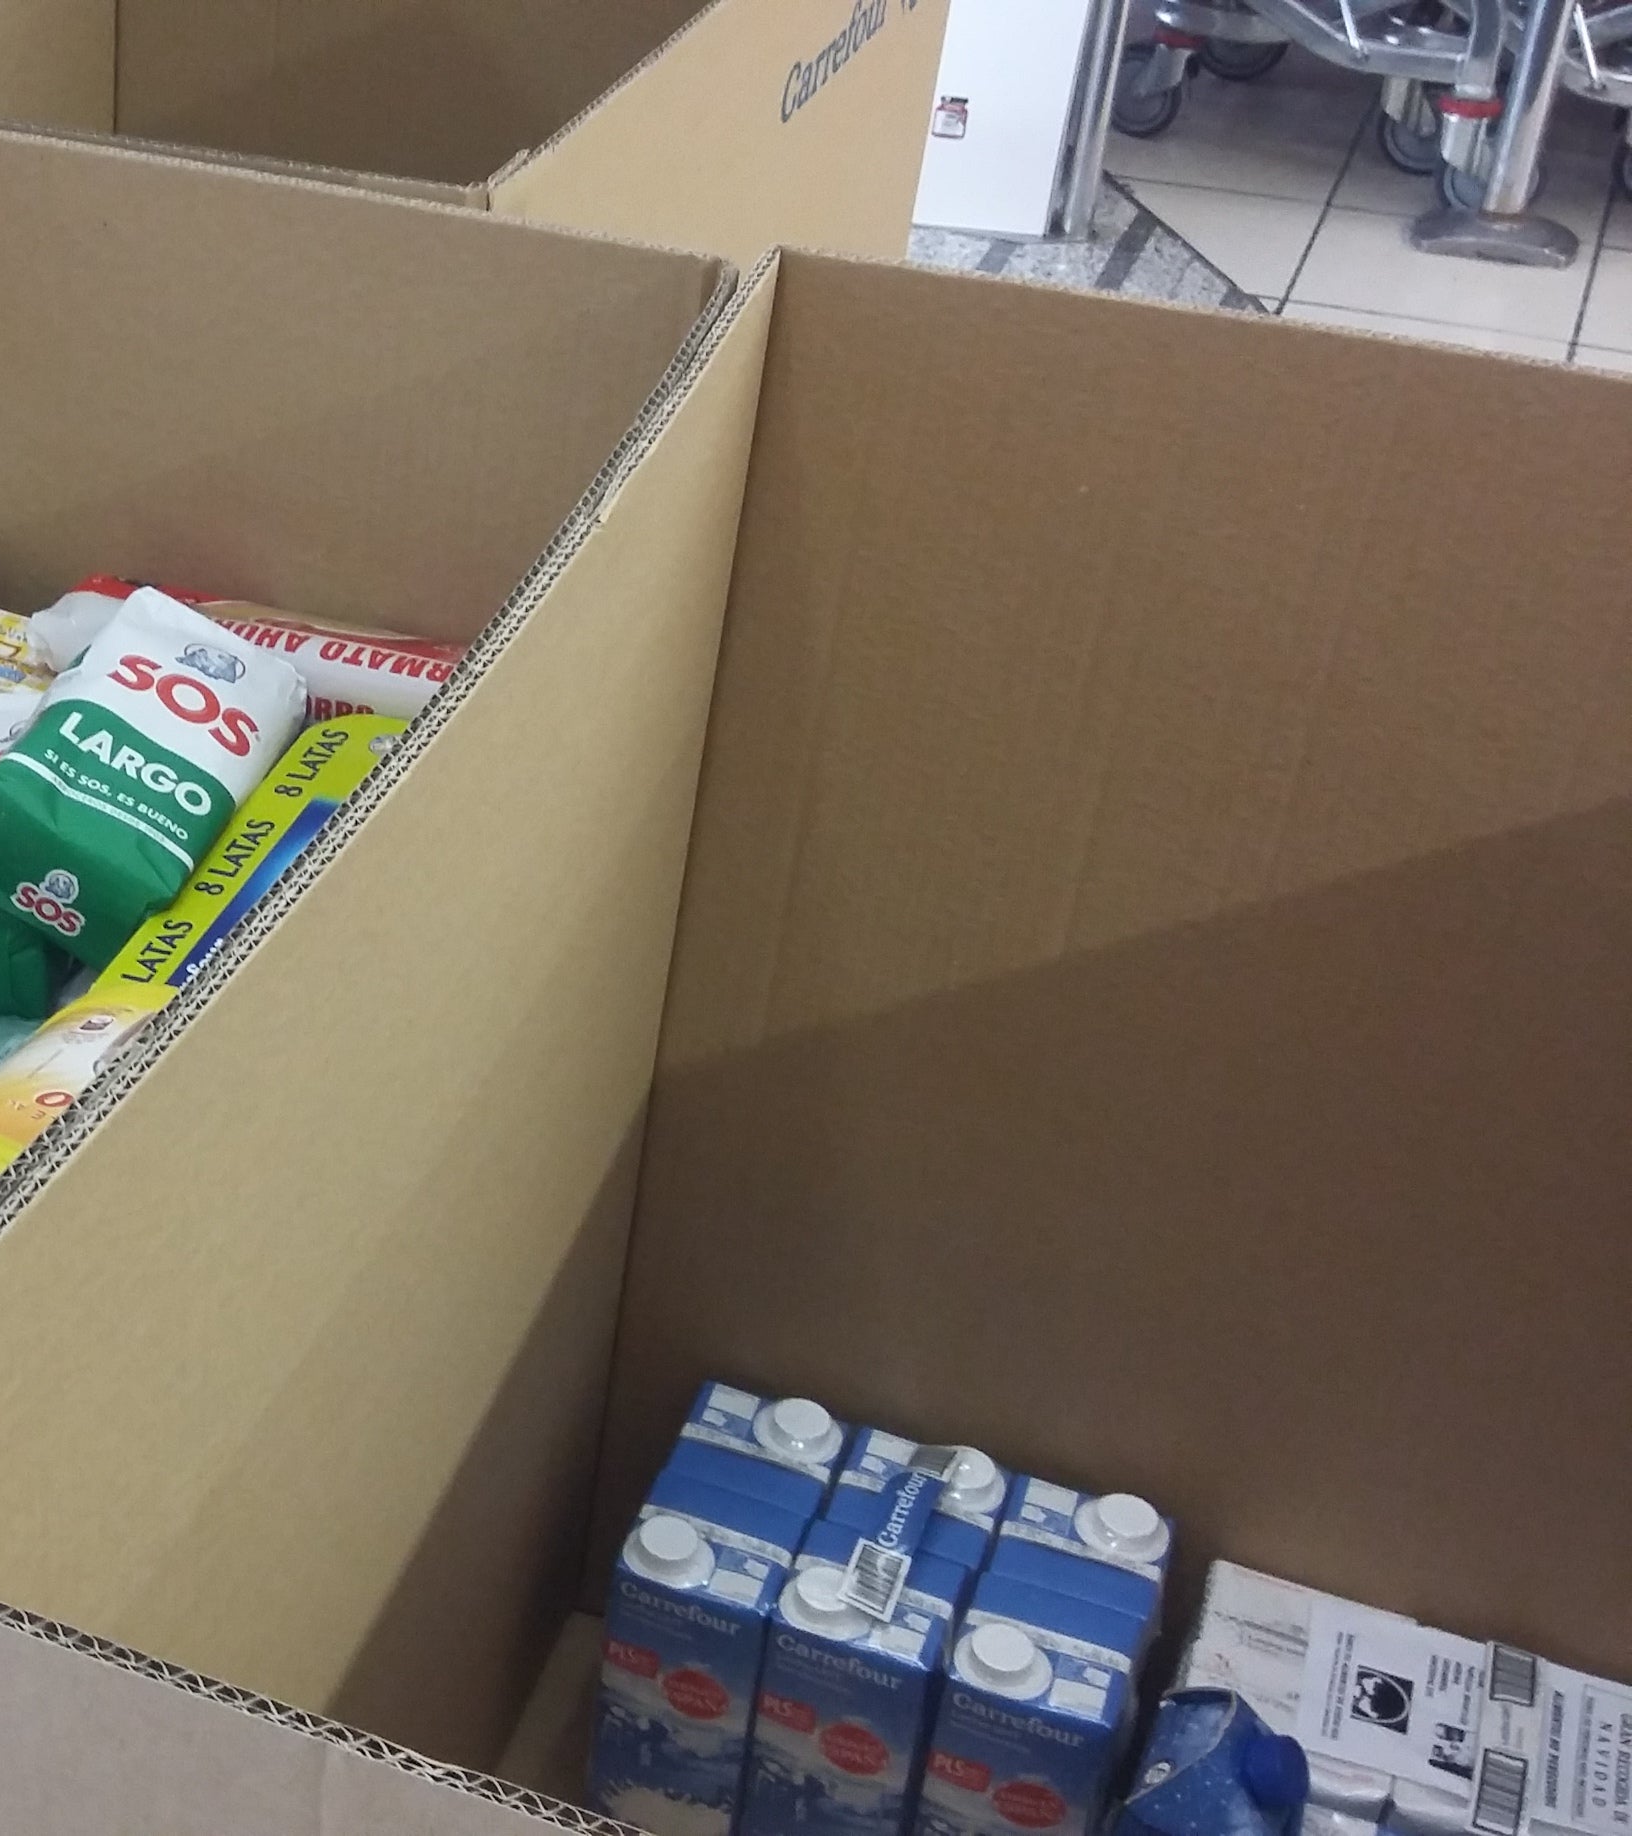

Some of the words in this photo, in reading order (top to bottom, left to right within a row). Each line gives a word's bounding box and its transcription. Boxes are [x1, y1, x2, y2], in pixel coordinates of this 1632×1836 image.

[106, 654, 260, 757] SOS
[59, 711, 212, 817] LARGO
[286, 728, 350, 781] LATAS
[44, 749, 59, 765] SI
[59, 761, 77, 778] ES
[116, 792, 136, 808] ES
[137, 803, 189, 841] BUENO
[274, 784, 304, 798] 8
[207, 819, 276, 878] LATAS
[15, 885, 83, 933] SOS
[194, 881, 225, 895] 8
[121, 919, 194, 984] LATAS
[621, 1581, 741, 1636] Carrefour
[777, 1634, 902, 1690] Carrefour
[953, 1692, 1085, 1747] Carrefour
